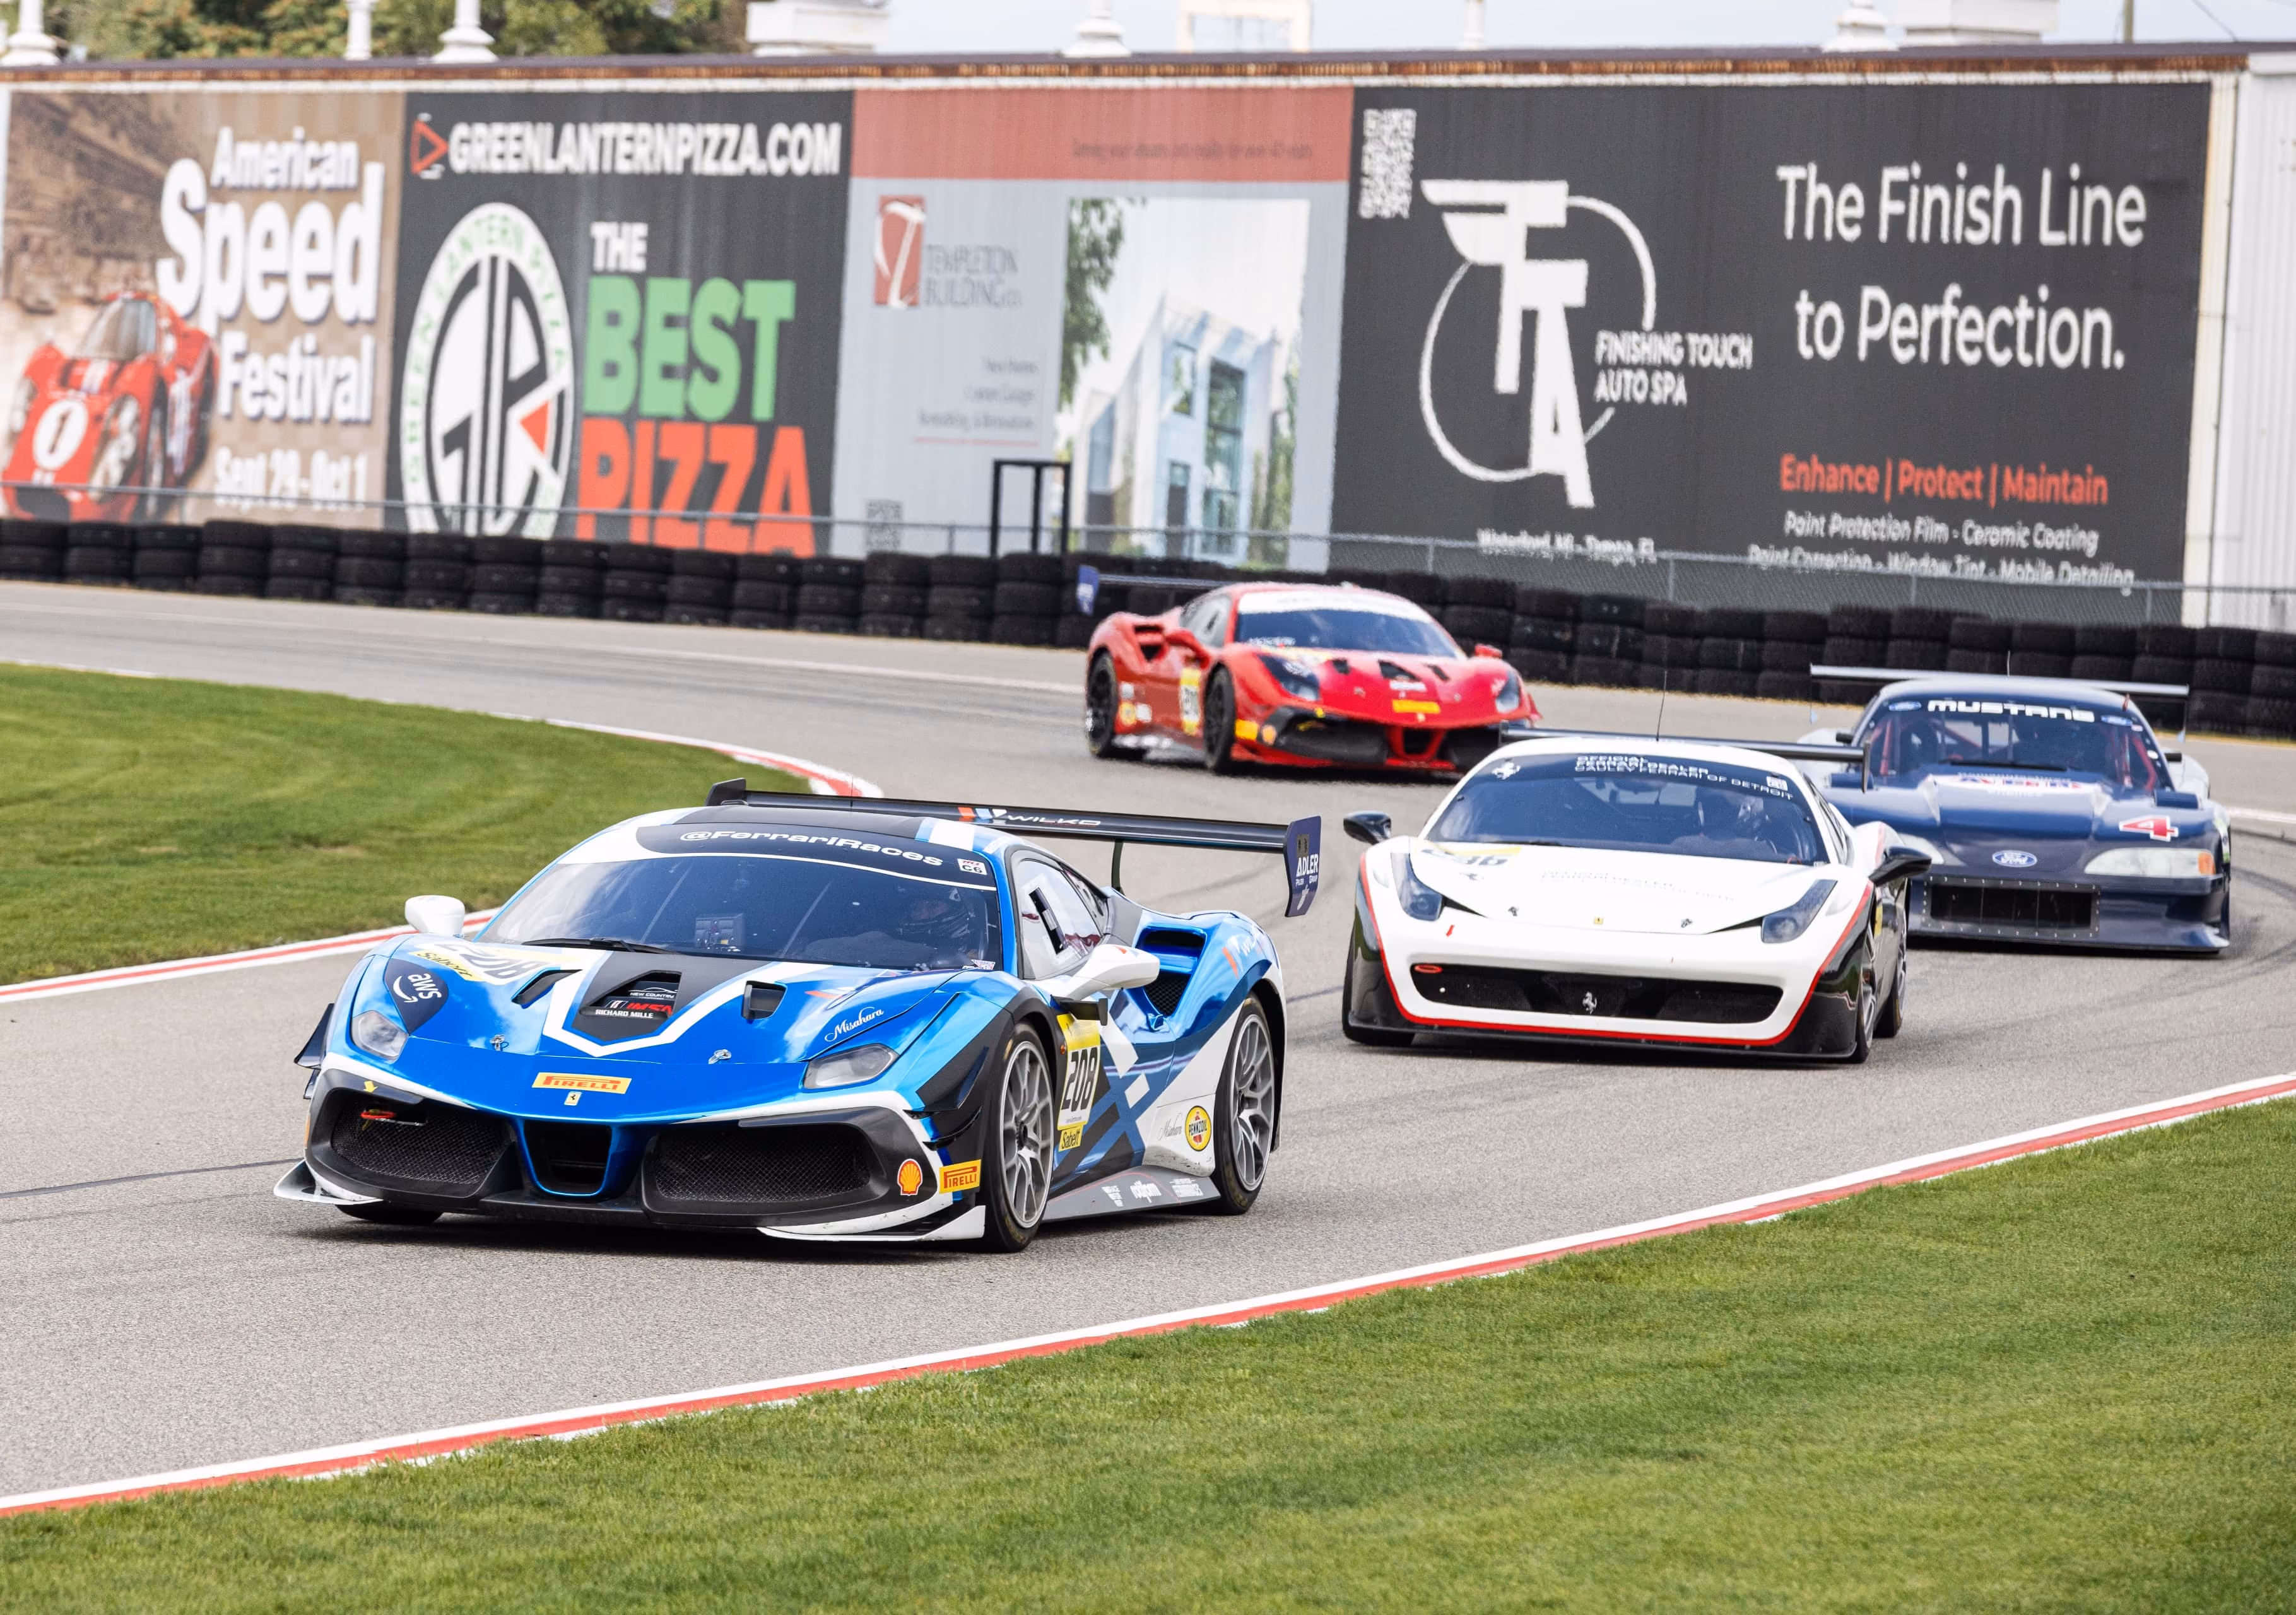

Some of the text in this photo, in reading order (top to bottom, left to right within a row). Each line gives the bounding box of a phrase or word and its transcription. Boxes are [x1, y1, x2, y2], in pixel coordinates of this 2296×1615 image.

[211, 126, 358, 189] American
[449, 122, 841, 177] GREENLANTERNPIZZA.COM
[1777, 161, 2146, 247] The Finish Line
[156, 158, 384, 336] Speed
[591, 221, 648, 273] THE
[1796, 283, 2125, 370] to Perfection.
[581, 276, 796, 422] BEST
[1595, 331, 1753, 370] FINISHING TOUCH
[218, 331, 375, 423] Festival
[1594, 370, 1687, 406] AUTO SPA
[575, 417, 816, 558] PIZZA
[1780, 454, 1880, 493] Enhance
[1898, 459, 1984, 500] Protect
[2003, 463, 2109, 505] Maintain
[1828, 513, 1912, 543] Protection
[1914, 515, 1949, 544] Film
[1962, 519, 2030, 548] Ceramic
[2033, 522, 2099, 558] Coating
[1999, 556, 2054, 583] Mobile
[2058, 560, 2134, 596] Detailing
[1928, 700, 2095, 722] MUSTANG
[1731, 779, 1794, 800] DETROIT
[1008, 814, 1101, 826] WILKO
[2119, 815, 2179, 842] 4
[680, 831, 944, 866] @FerrariRaces
[1296, 854, 1319, 877] ADLER
[962, 865, 982, 873] C6
[408, 973, 442, 999] aws
[595, 1009, 629, 1017] RICHARD
[627, 1002, 673, 1016] IMSA
[824, 1006, 884, 1042] Misahara
[543, 1076, 621, 1090] PIRELLI
[1061, 1047, 1098, 1112] 208
[1061, 1129, 1081, 1149] Sabelt
[1189, 1119, 1208, 1136] PENNZOIL
[944, 1166, 977, 1189] PIRELLI
